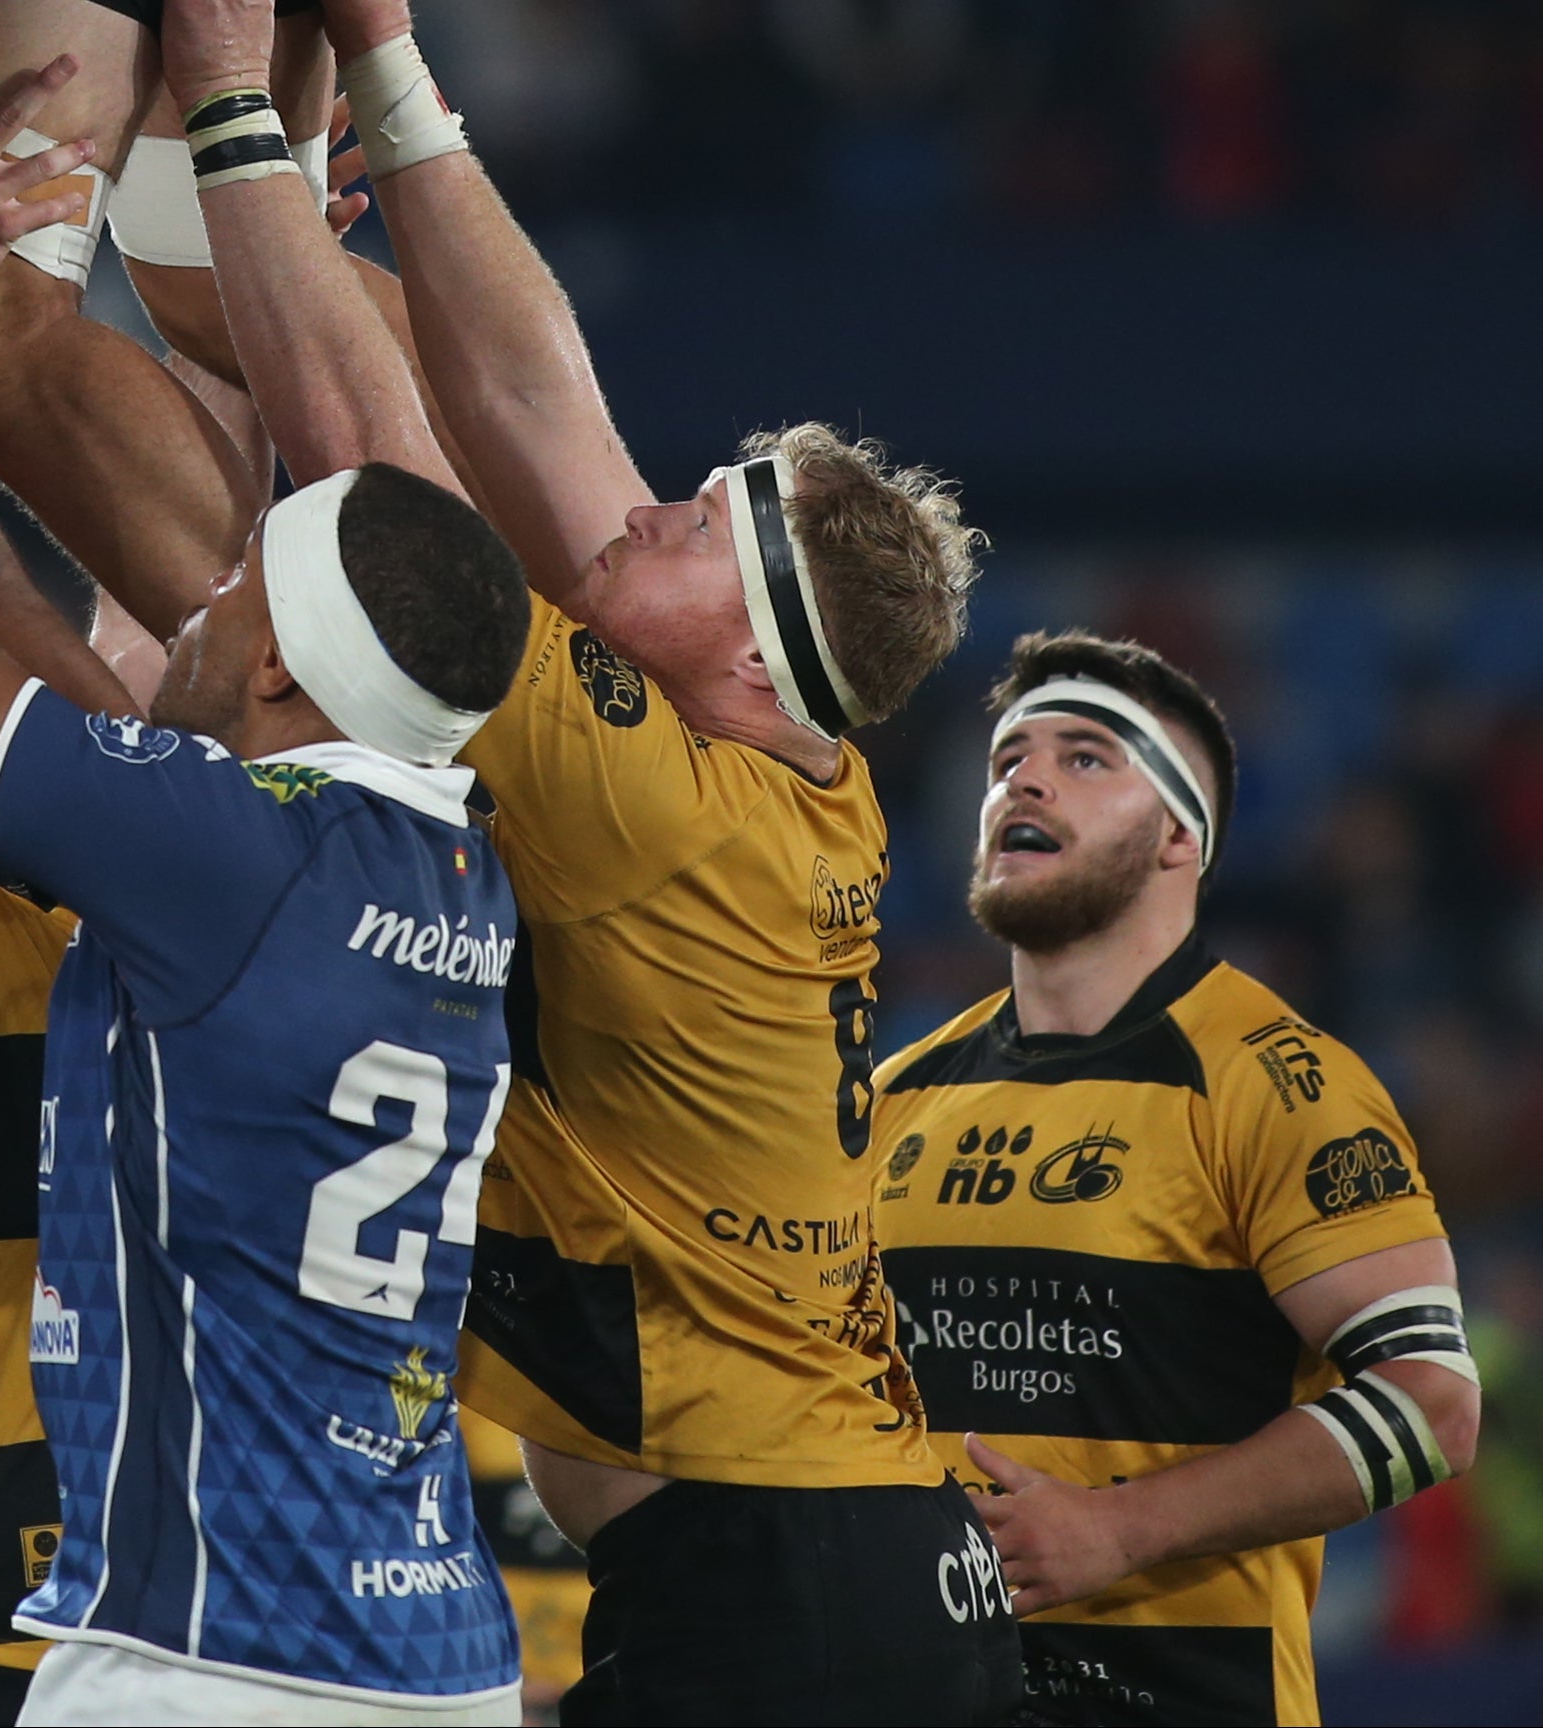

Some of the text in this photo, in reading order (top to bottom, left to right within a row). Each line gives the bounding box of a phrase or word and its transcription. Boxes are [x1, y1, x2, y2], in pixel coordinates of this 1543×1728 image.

[347, 904, 516, 988] melénde
[937, 1159, 1017, 1205] nb
[932, 1277, 1120, 1308] HOSPITAL
[933, 1309, 1123, 1360] Recoletas
[972, 1362, 1077, 1403] Burgos
